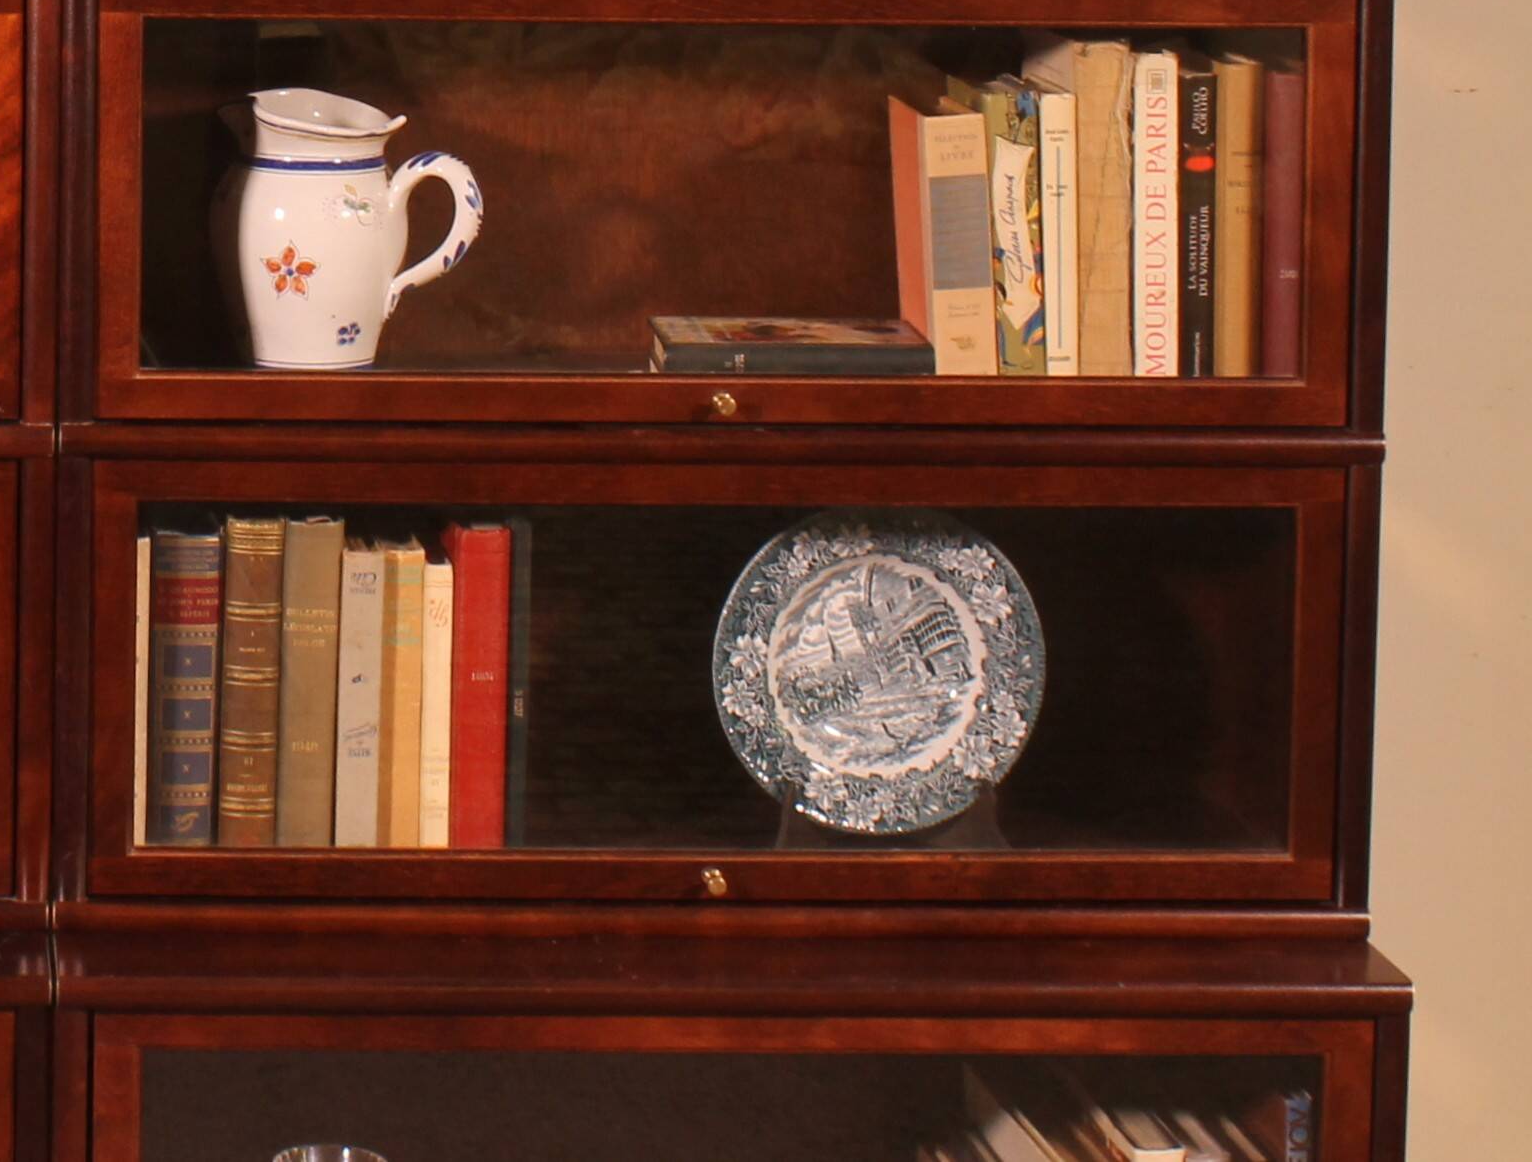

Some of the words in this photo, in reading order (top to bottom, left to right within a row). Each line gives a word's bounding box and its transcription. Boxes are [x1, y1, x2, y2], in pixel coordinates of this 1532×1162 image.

[1191, 91, 1201, 130] PAULO
[1198, 86, 1208, 135] COELHO
[1146, 96, 1168, 174] PARIS
[1145, 185, 1167, 222] DE
[1187, 214, 1198, 272] SOLITUDE
[1199, 205, 1210, 275] VAINQUEUR
[1187, 275, 1197, 290] LA
[1199, 278, 1209, 297] DU
